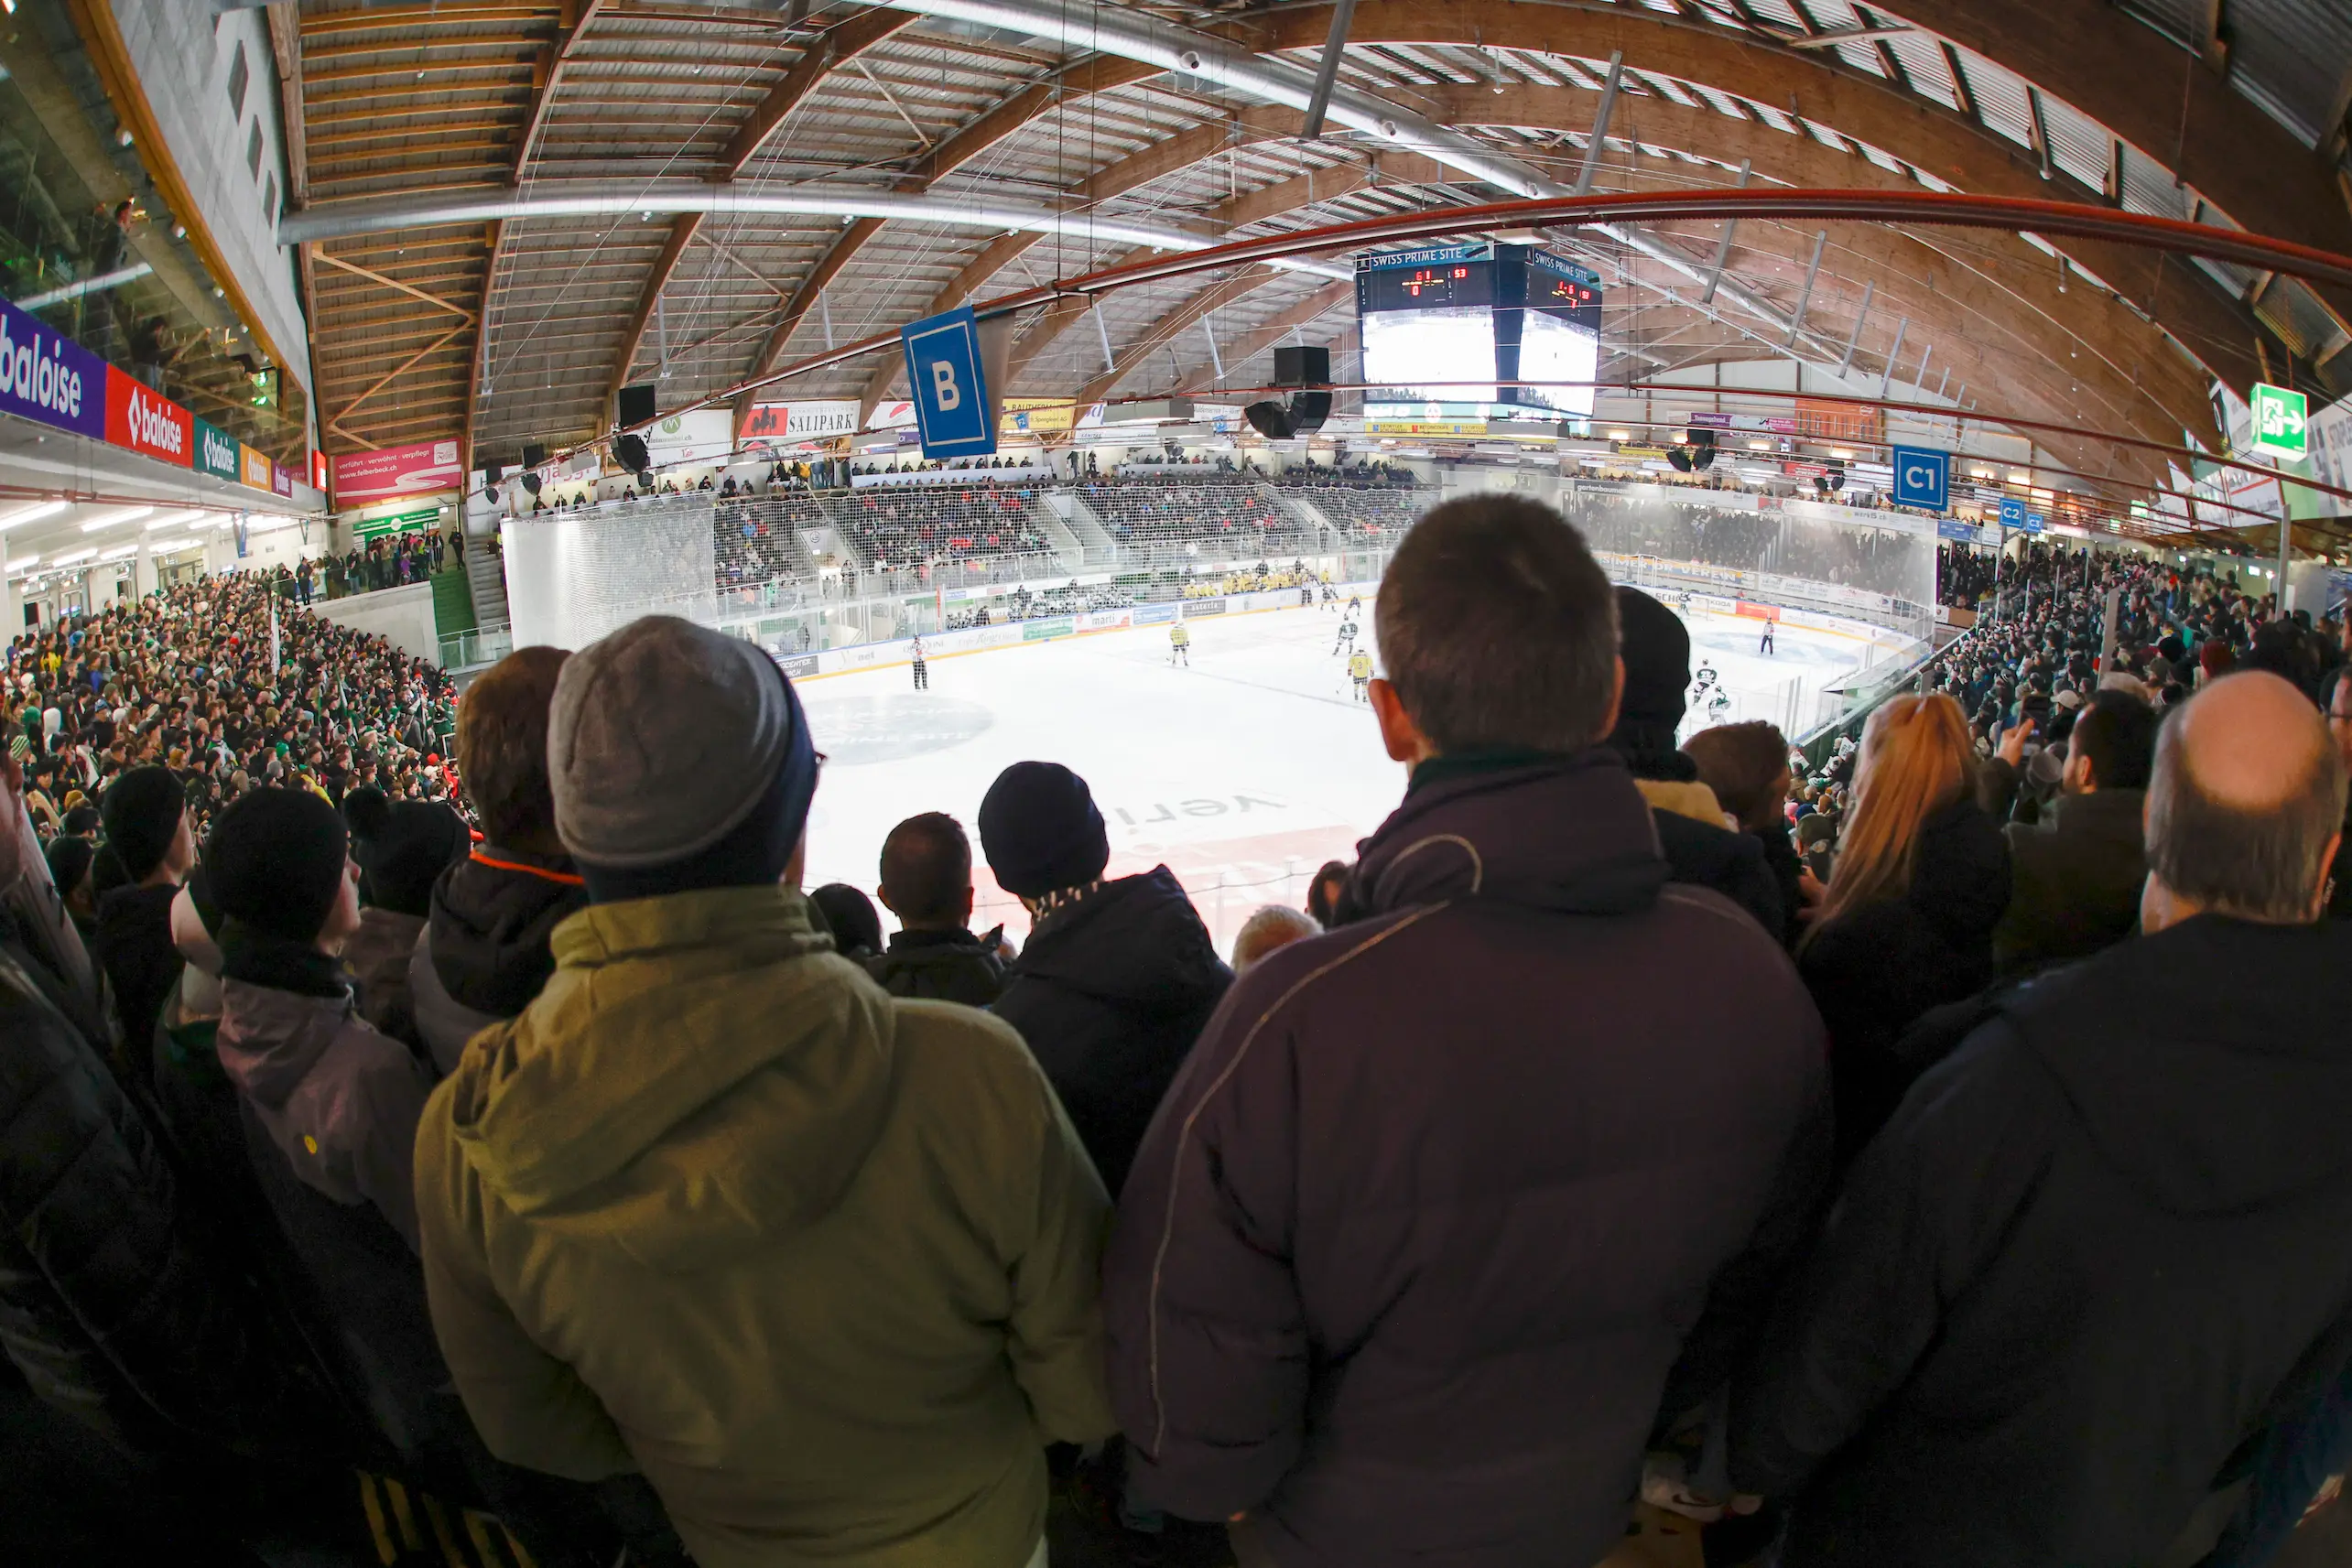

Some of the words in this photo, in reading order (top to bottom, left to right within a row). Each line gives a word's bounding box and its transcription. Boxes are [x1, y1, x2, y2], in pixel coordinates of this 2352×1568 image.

[1373, 254, 1402, 266] SWISS
[1405, 251, 1436, 263] PRIME
[1439, 248, 1462, 260] SITE
[1535, 253, 1555, 268] SWISS
[1555, 260, 1574, 276] PRIME
[1575, 268, 1588, 282] SITE
[0, 314, 81, 418] baloise
[932, 360, 960, 412] B
[142, 395, 182, 455] baloise
[211, 432, 234, 473] baloise
[339, 460, 363, 470] verführt
[368, 454, 397, 465] verwöhnt
[402, 449, 429, 460] verpflegt
[339, 465, 397, 481] www.felberbeck.ch
[1905, 466, 1935, 491] C1
[2002, 506, 2020, 520] C2
[2028, 518, 2040, 526] C3
[1681, 566, 1737, 583] VEREIN
[1092, 613, 1116, 625] marti
[1358, 661, 1363, 670] 3
